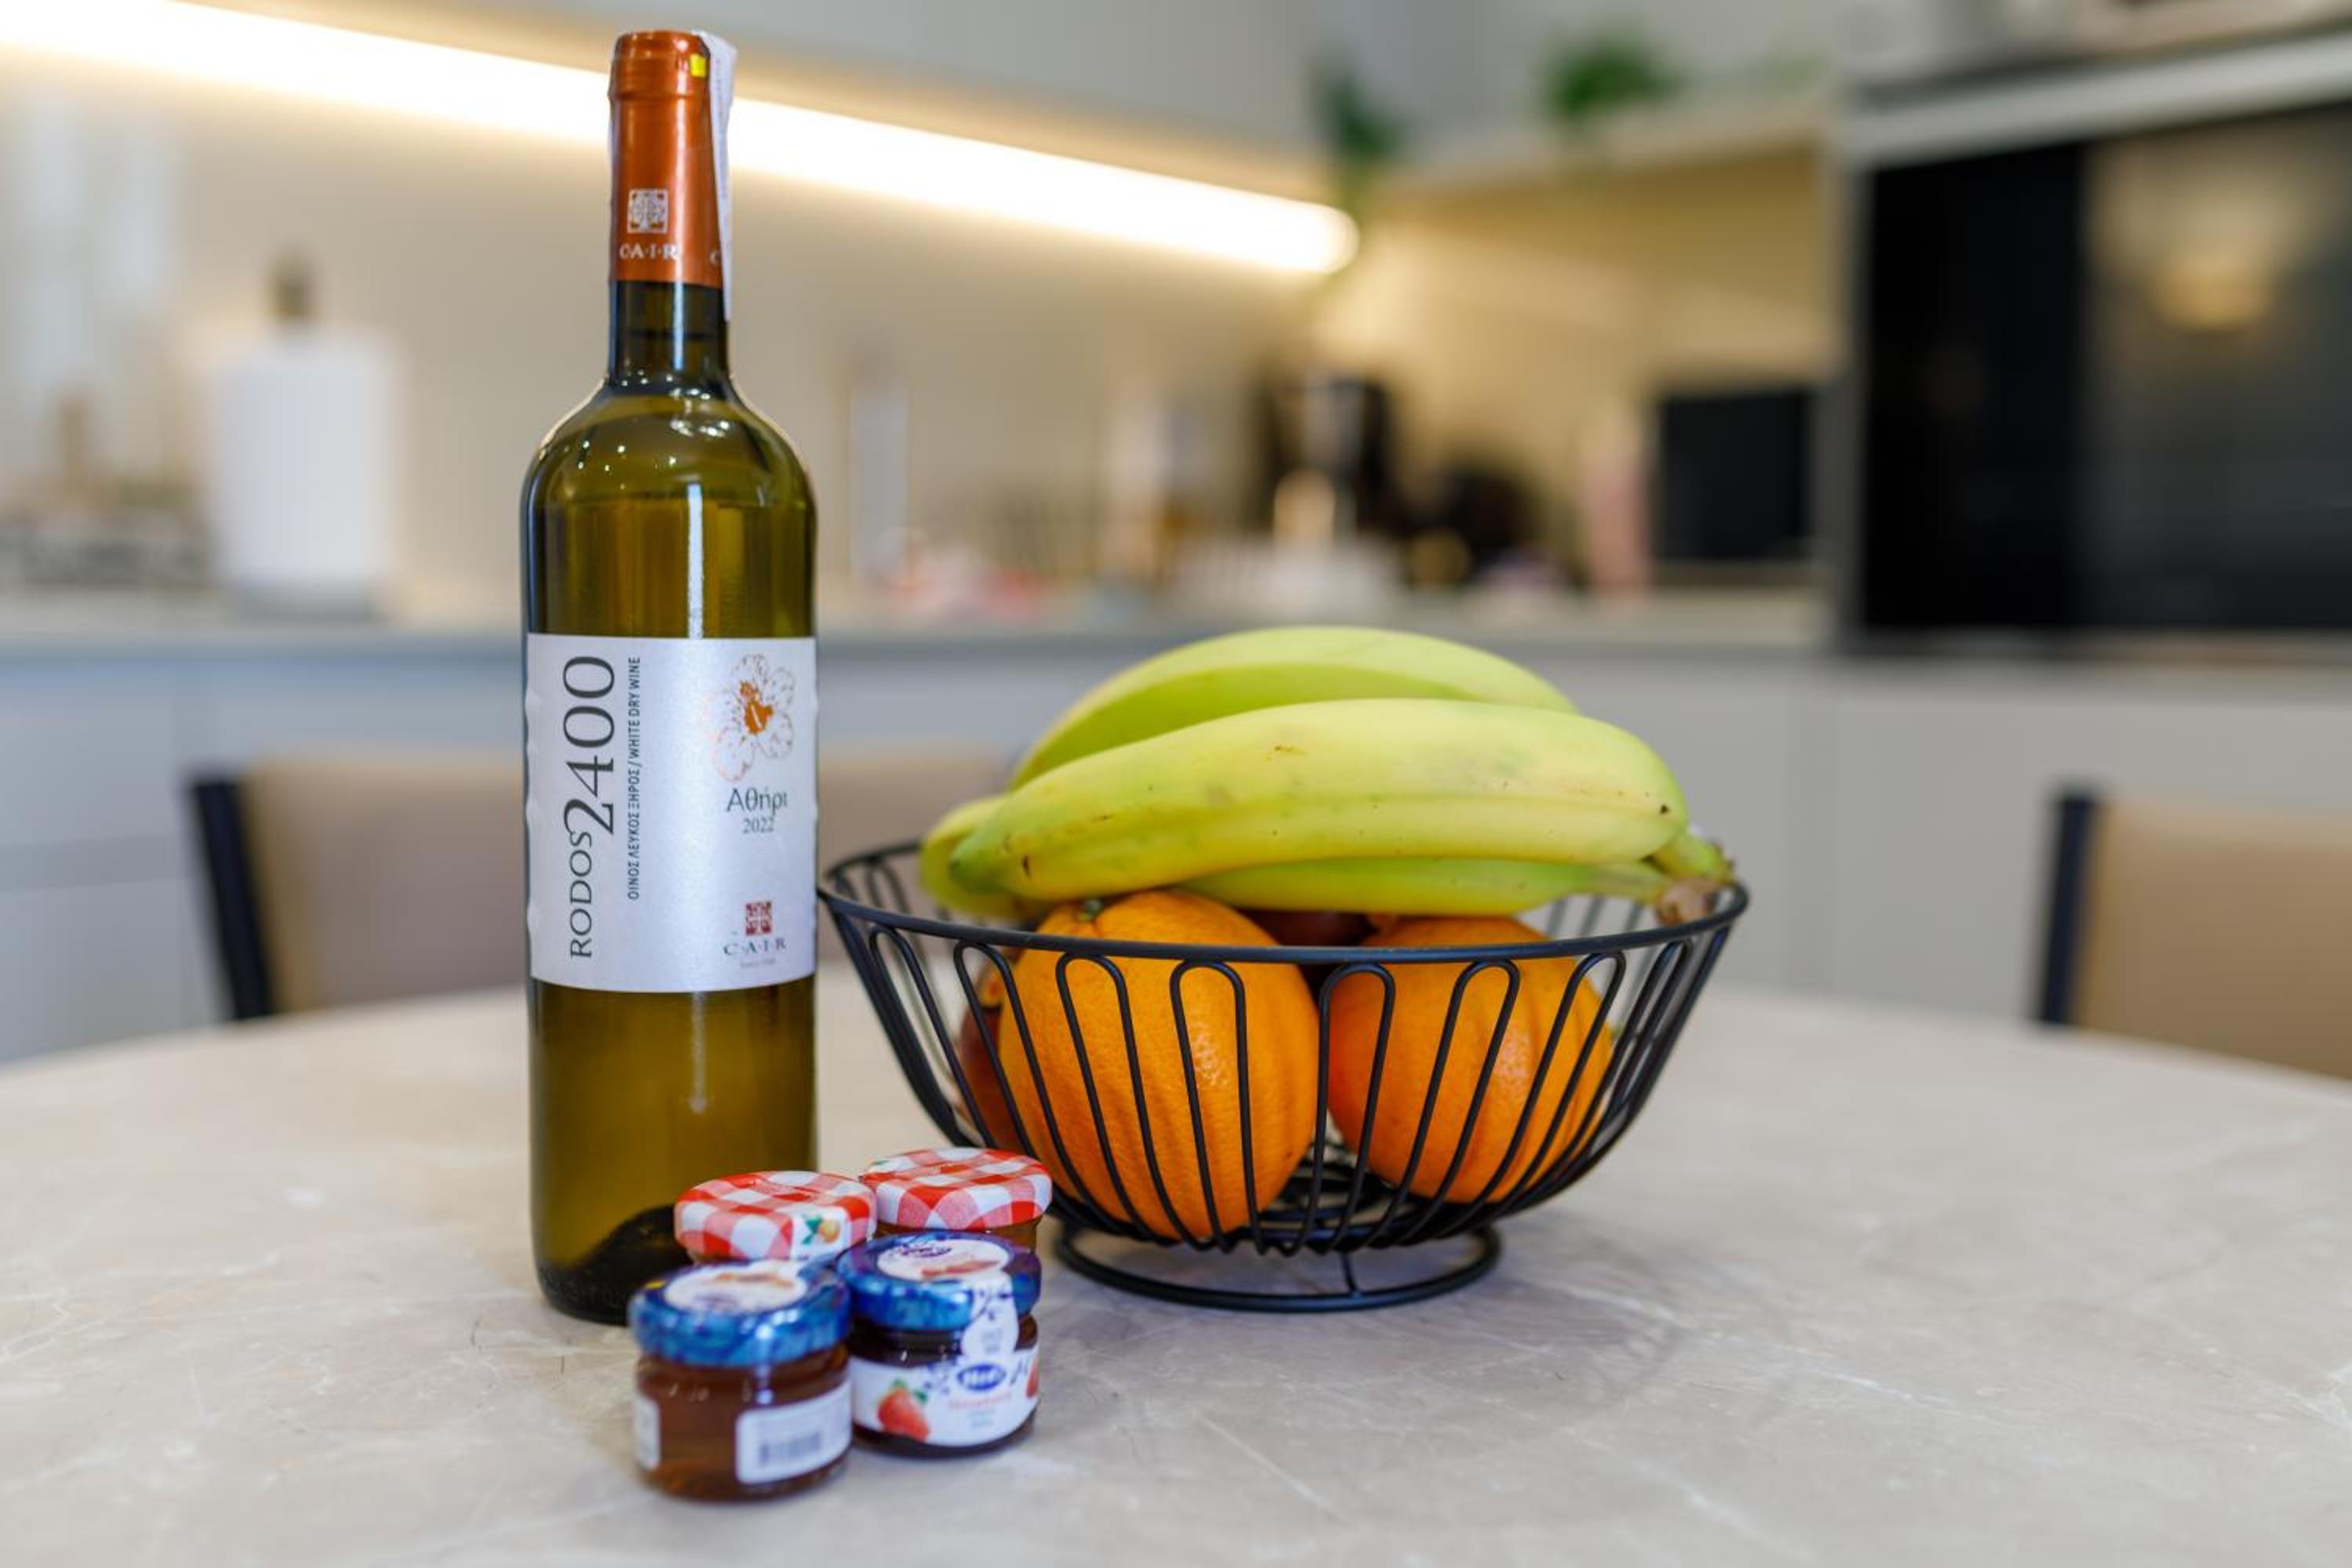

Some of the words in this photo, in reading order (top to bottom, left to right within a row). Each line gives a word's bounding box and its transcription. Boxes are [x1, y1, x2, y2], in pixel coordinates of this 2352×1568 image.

[628, 656, 641, 690] WINE
[628, 692, 640, 717] DRY
[628, 719, 640, 759] WHITE
[628, 812, 640, 859] ΛΕΥΚΟΣ
[742, 817, 775, 833] 2022
[628, 862, 640, 901] ΟΙΝΟΣ
